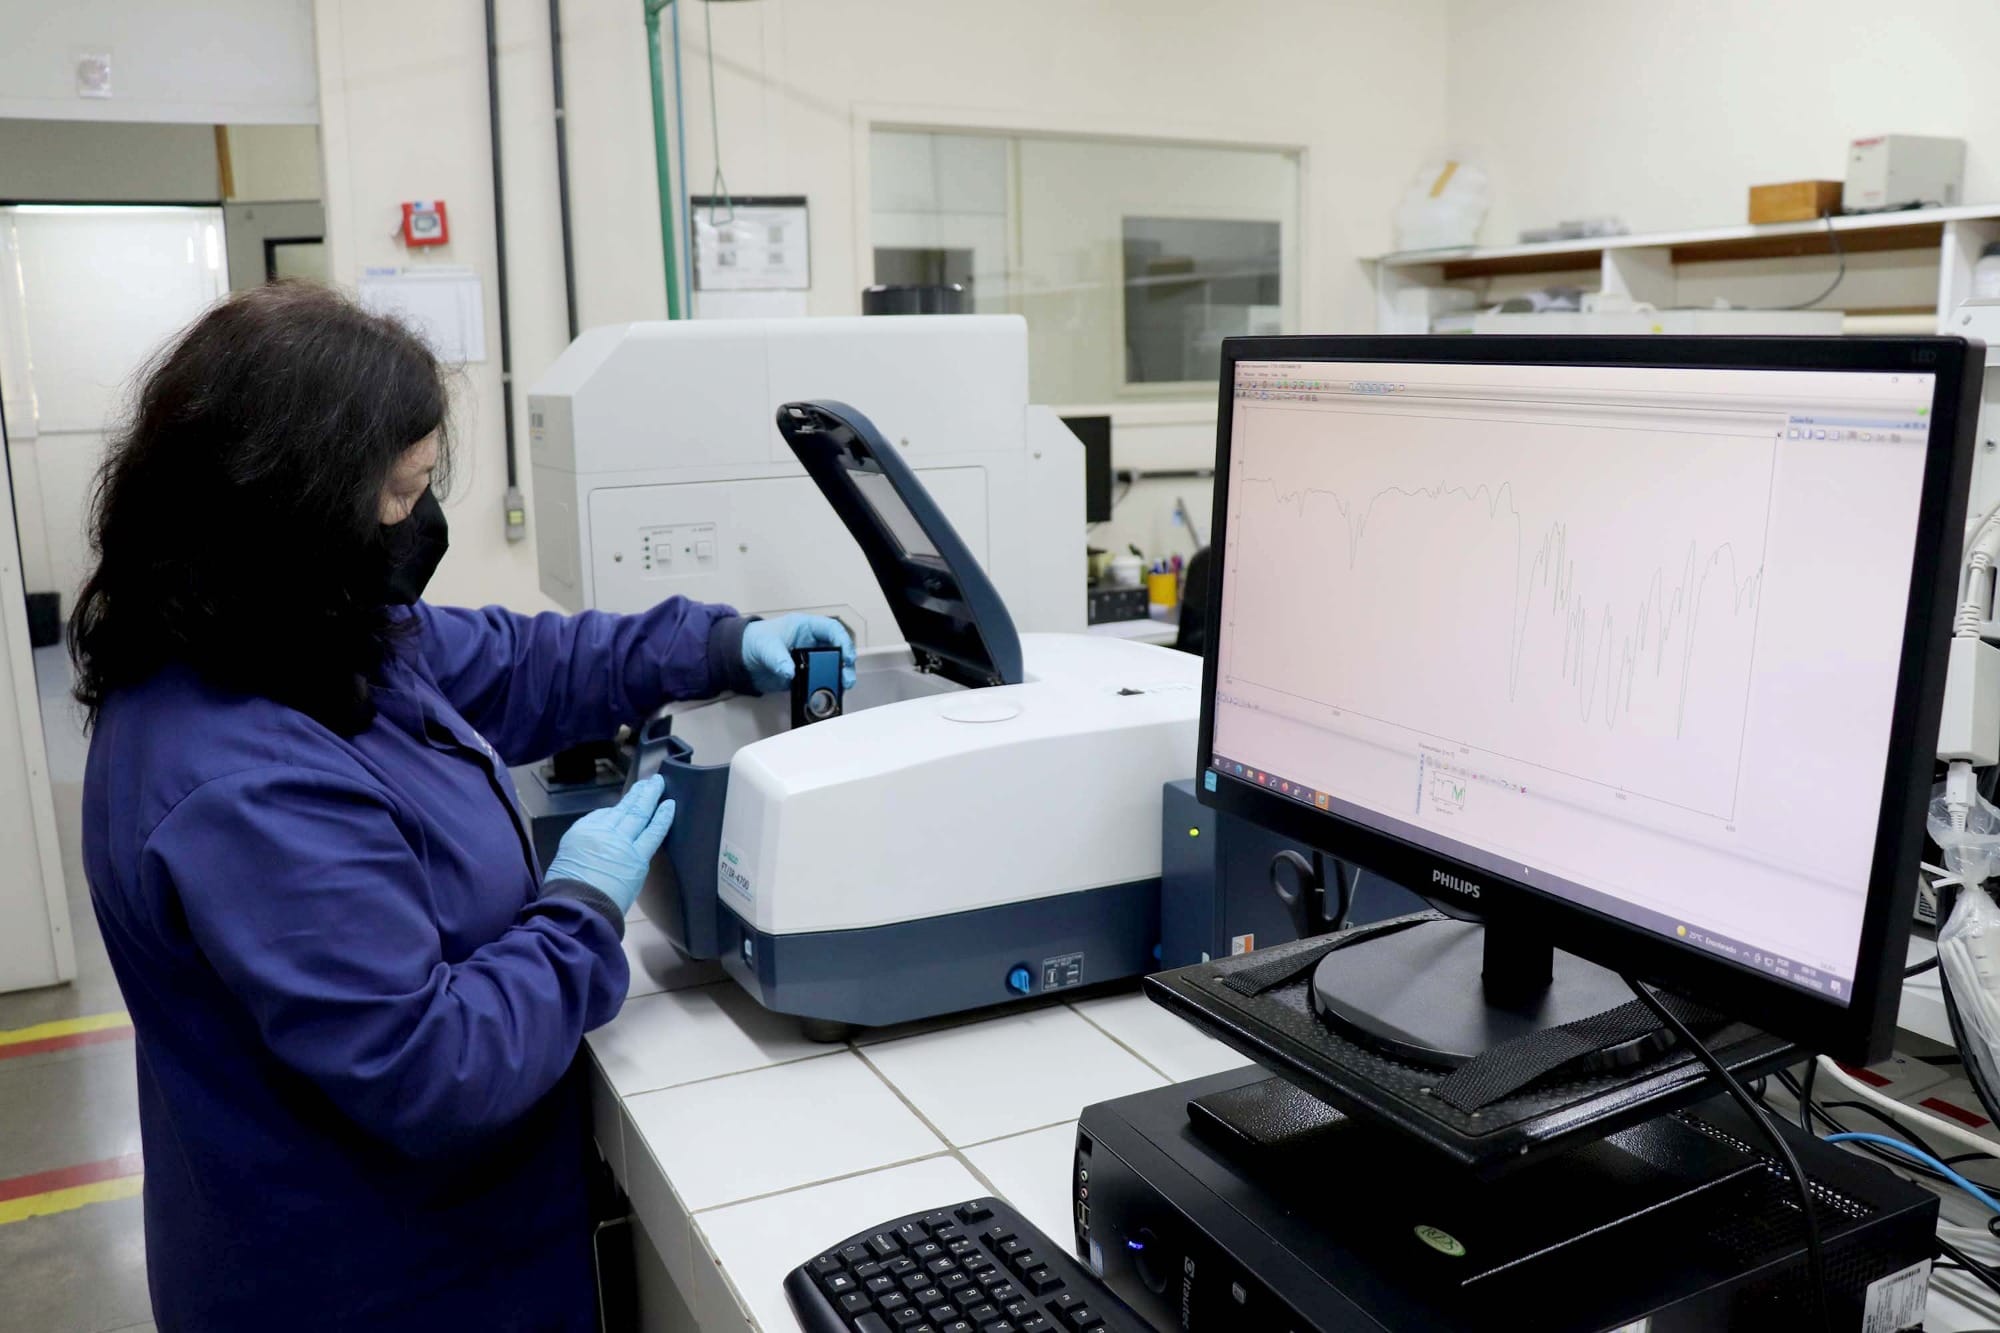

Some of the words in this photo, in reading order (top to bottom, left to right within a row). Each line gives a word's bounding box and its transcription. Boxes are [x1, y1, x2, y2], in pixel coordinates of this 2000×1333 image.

[1432, 869, 1481, 899] PHILIPS
[938, 1258, 951, 1267] W
[952, 1273, 962, 1281] E
[890, 1293, 900, 1301] X
[904, 1309, 915, 1317] C
[917, 1324, 929, 1332] V
[955, 1322, 966, 1330] G
[997, 1321, 1008, 1329] Y
